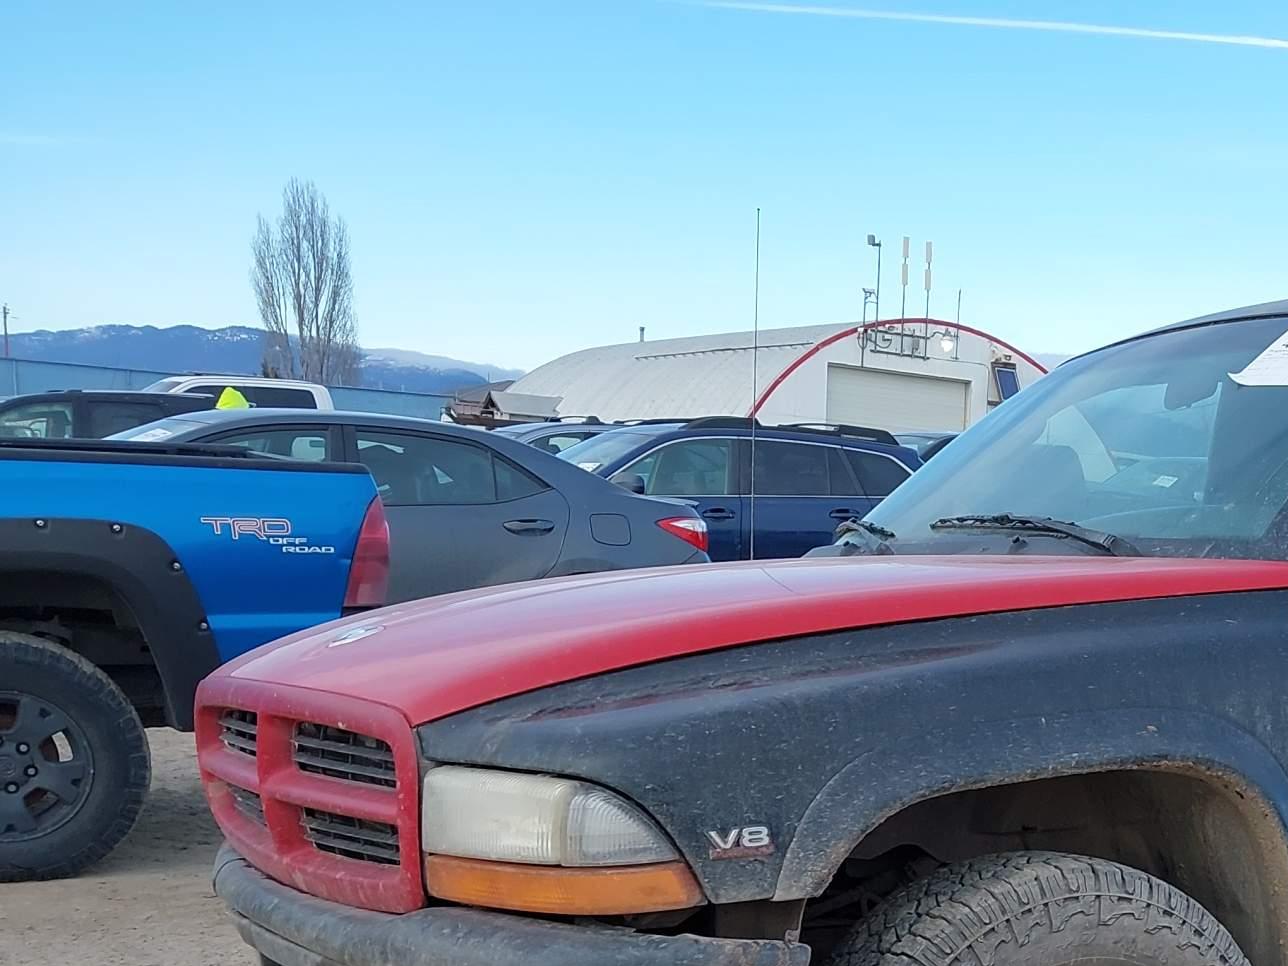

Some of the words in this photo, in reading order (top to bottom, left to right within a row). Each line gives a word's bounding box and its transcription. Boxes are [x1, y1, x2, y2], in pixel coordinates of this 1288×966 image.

[200, 517, 291, 540] TRD
[269, 537, 307, 545] OFF
[704, 826, 770, 849] V8
